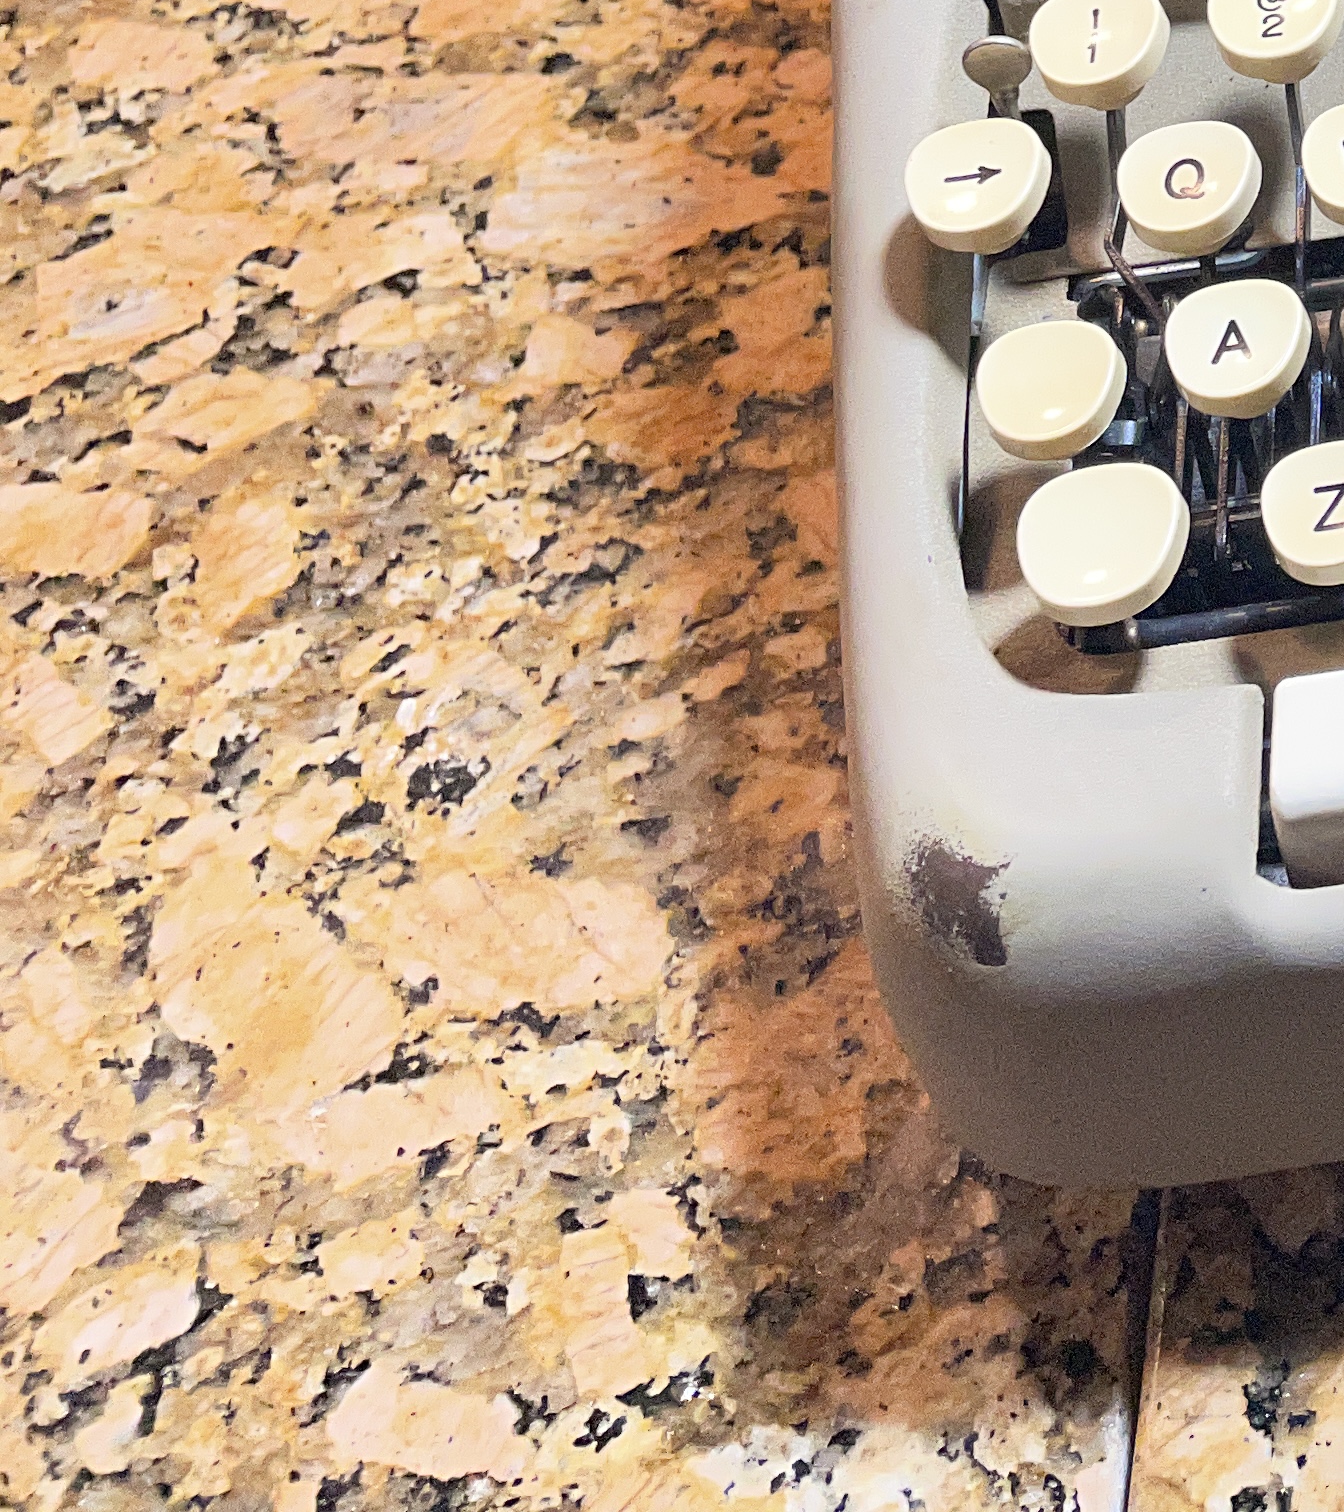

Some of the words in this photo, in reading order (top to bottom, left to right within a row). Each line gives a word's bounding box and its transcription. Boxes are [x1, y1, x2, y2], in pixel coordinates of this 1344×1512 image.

[1261, 14, 1284, 38] 2
[1164, 158, 1206, 201] Q
[1210, 319, 1252, 365] A
